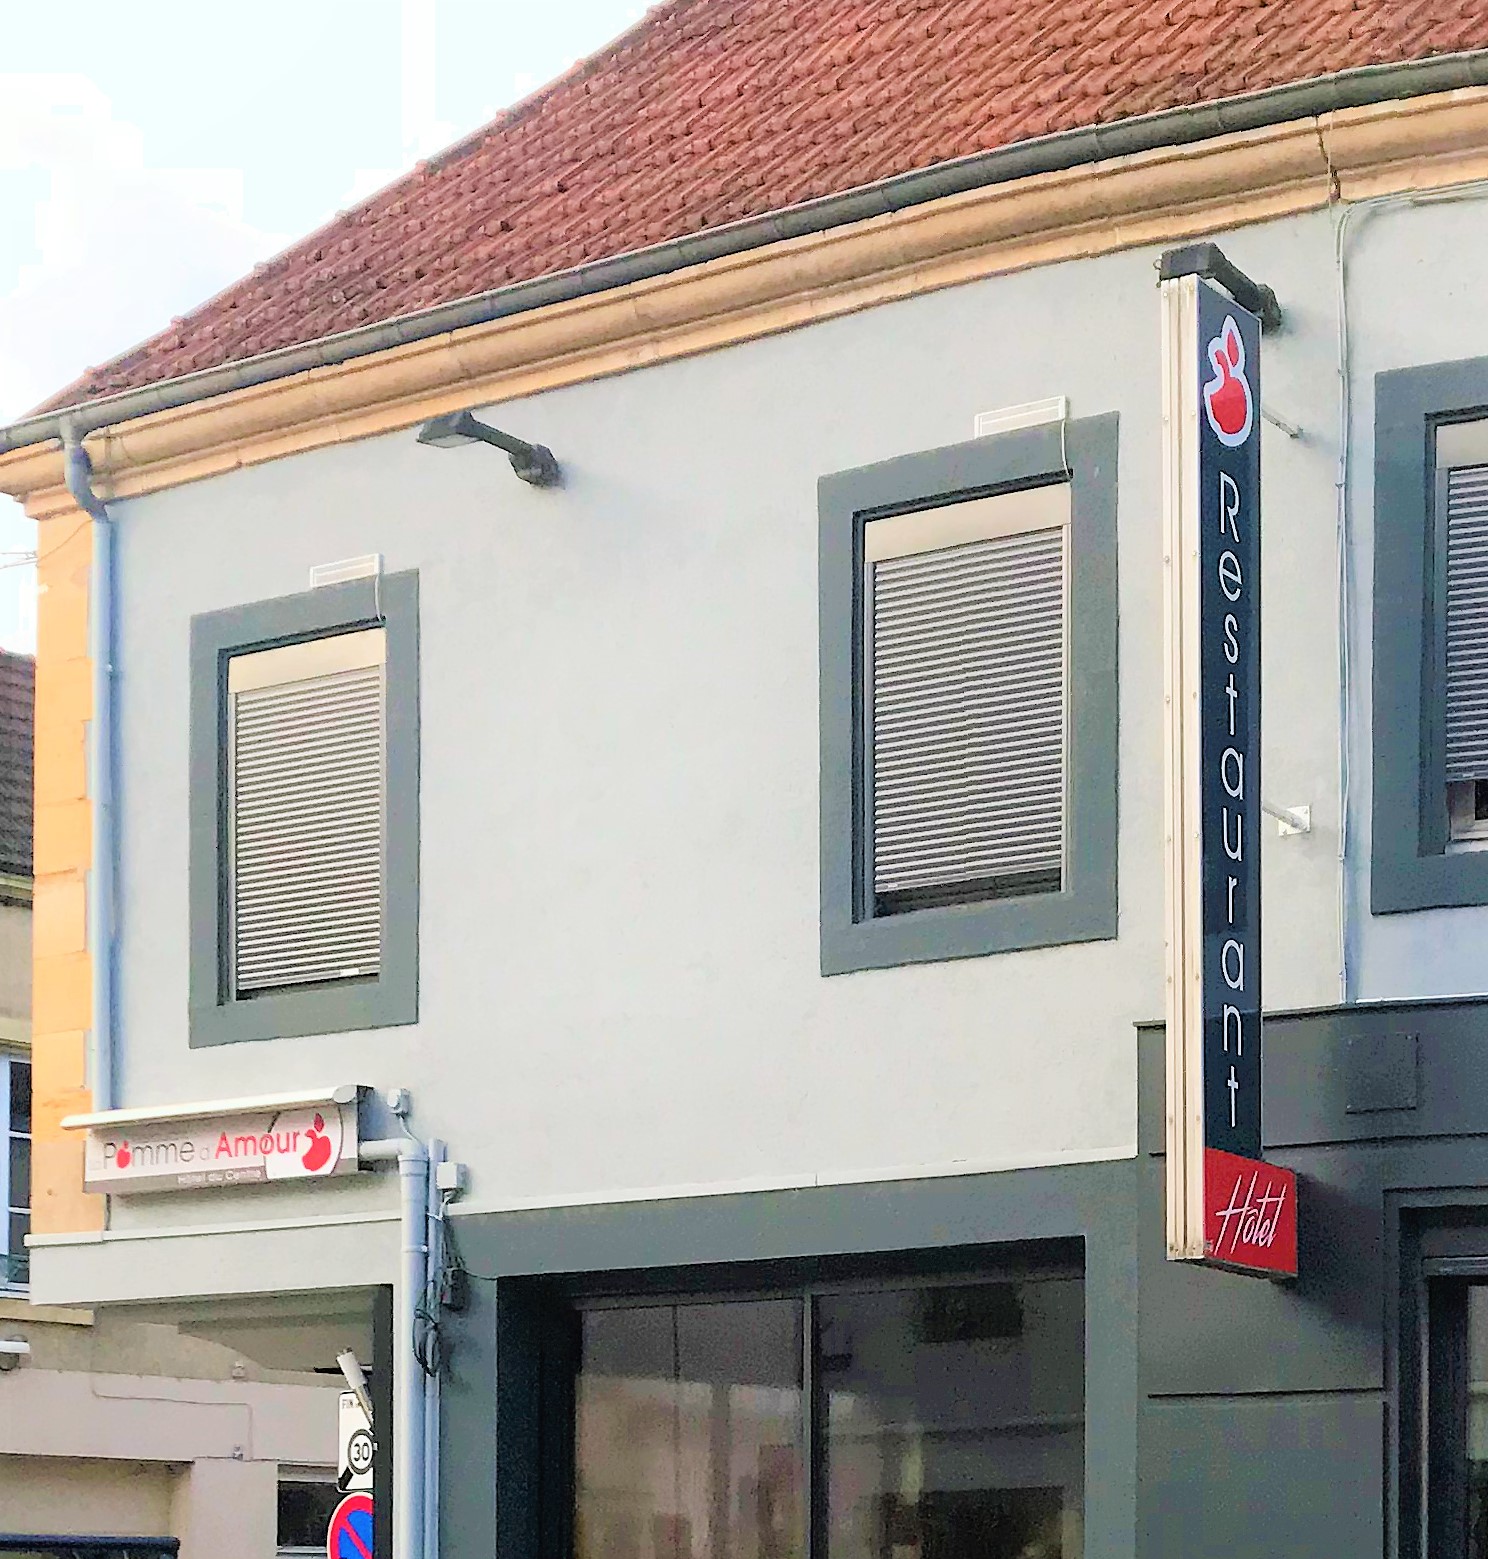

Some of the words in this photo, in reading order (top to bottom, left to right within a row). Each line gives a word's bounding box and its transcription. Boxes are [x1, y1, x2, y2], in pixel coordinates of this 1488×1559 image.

[1217, 469, 1246, 1129] Restaurant
[1213, 1170, 1288, 1256] Hôtel
[353, 1442, 370, 1462] 30
